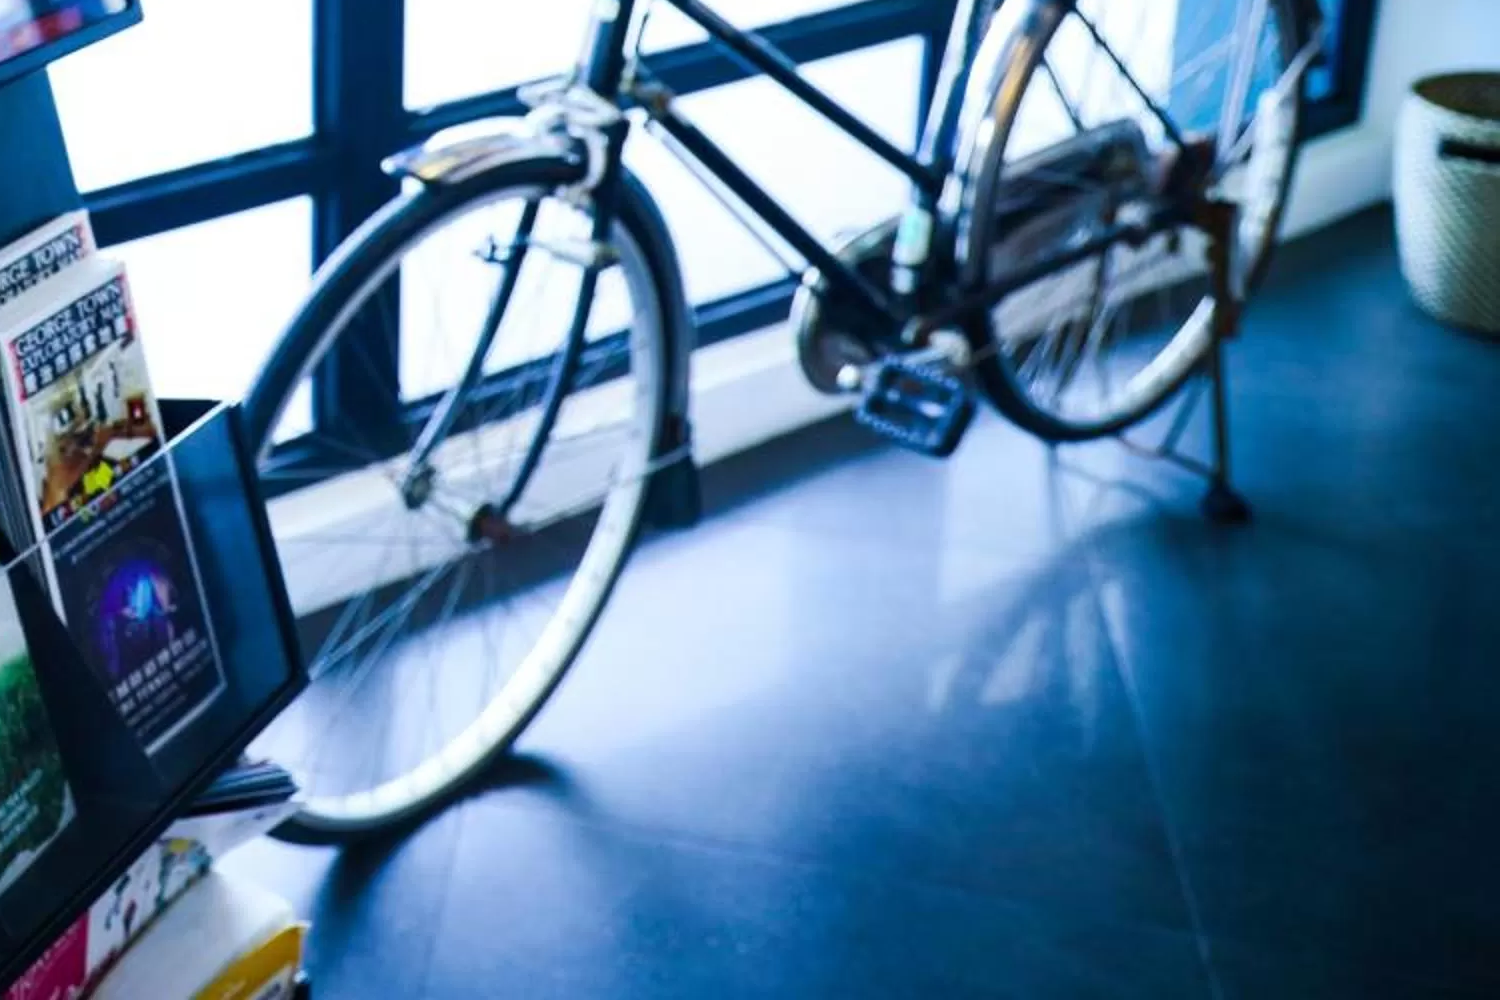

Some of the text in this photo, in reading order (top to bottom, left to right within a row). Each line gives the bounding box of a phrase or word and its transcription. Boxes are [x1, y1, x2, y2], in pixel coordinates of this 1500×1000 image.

[31, 233, 81, 267] TOWN
[15, 310, 74, 356] GEORGE
[76, 284, 122, 317] TOWN
